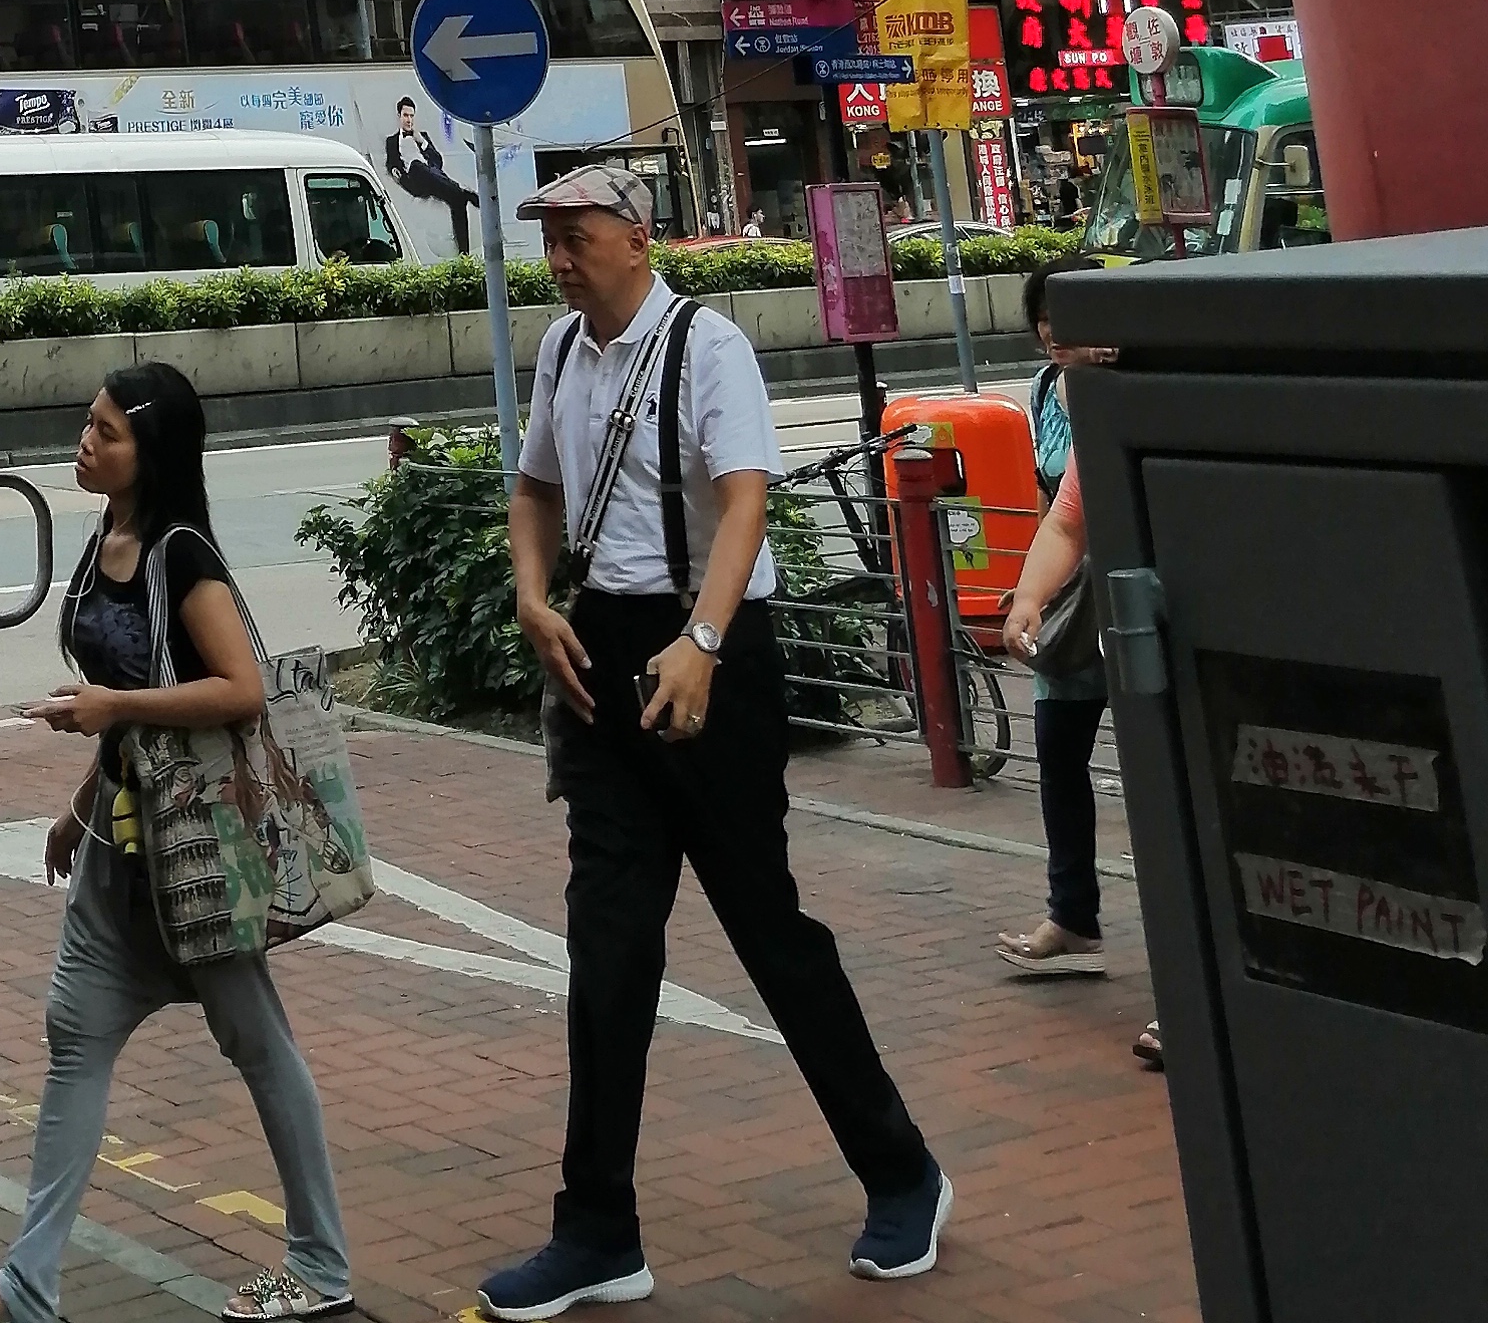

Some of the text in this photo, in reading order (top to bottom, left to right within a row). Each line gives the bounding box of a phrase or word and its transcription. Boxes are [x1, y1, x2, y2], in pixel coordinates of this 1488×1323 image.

[1063, 52, 1087, 65] SUN
[15, 93, 49, 114] Tempo
[161, 89, 196, 109] 全新
[972, 100, 1003, 112] ANGE
[847, 104, 881, 118] KONG
[127, 120, 186, 133] PRESTIGE
[1257, 867, 1466, 954] WET PAINT
